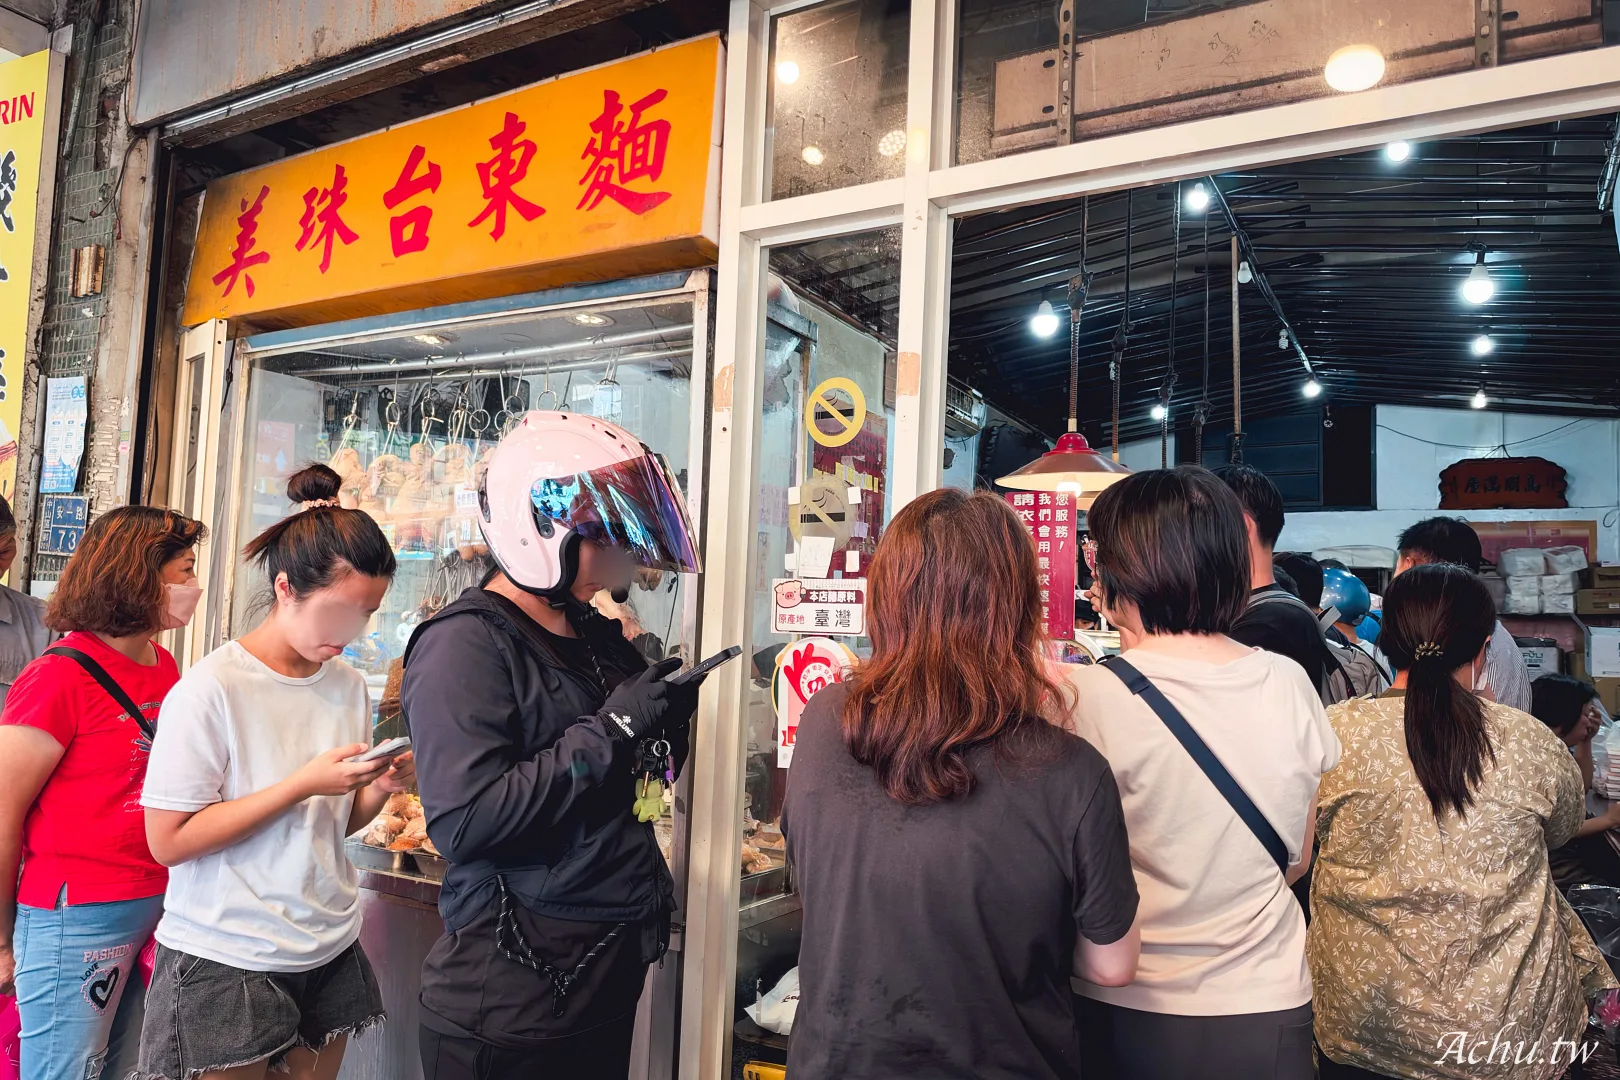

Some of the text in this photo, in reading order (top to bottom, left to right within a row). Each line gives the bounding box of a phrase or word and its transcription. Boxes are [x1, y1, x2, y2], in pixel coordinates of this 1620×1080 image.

[212, 88, 673, 298] 美珠台東麵
[57, 505, 85, 520] 安一路
[58, 530, 77, 551] 73
[778, 609, 851, 628] 原產地 臺灣
[82, 943, 134, 963] FASHION
[80, 963, 100, 981] LOVE
